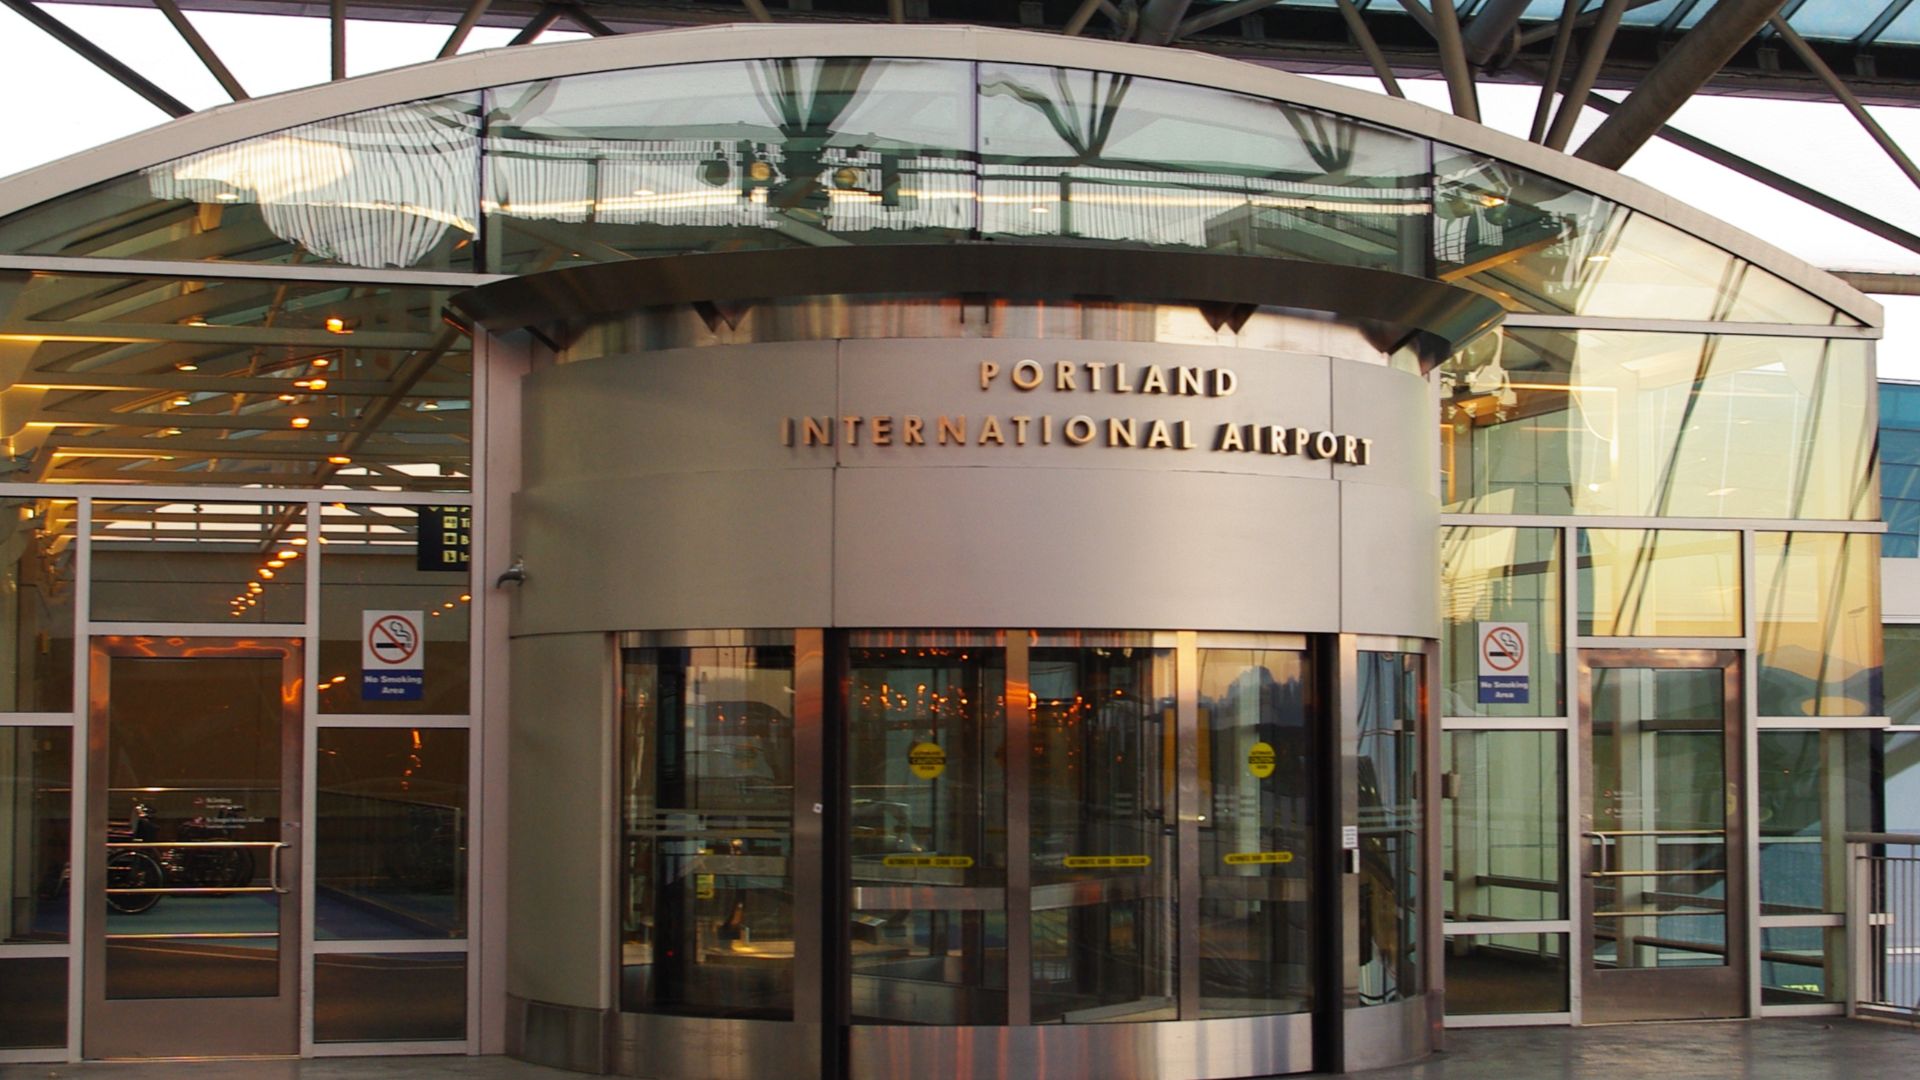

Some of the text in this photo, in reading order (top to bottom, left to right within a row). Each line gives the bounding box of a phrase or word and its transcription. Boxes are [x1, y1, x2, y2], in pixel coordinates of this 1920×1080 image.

[979, 358, 1238, 397] PORTLAND
[779, 414, 1374, 466] INTERNATIONAL AIRPORT
[364, 675, 423, 684] No Smoking
[1494, 681, 1528, 689] Smoking
[381, 686, 405, 694] Area
